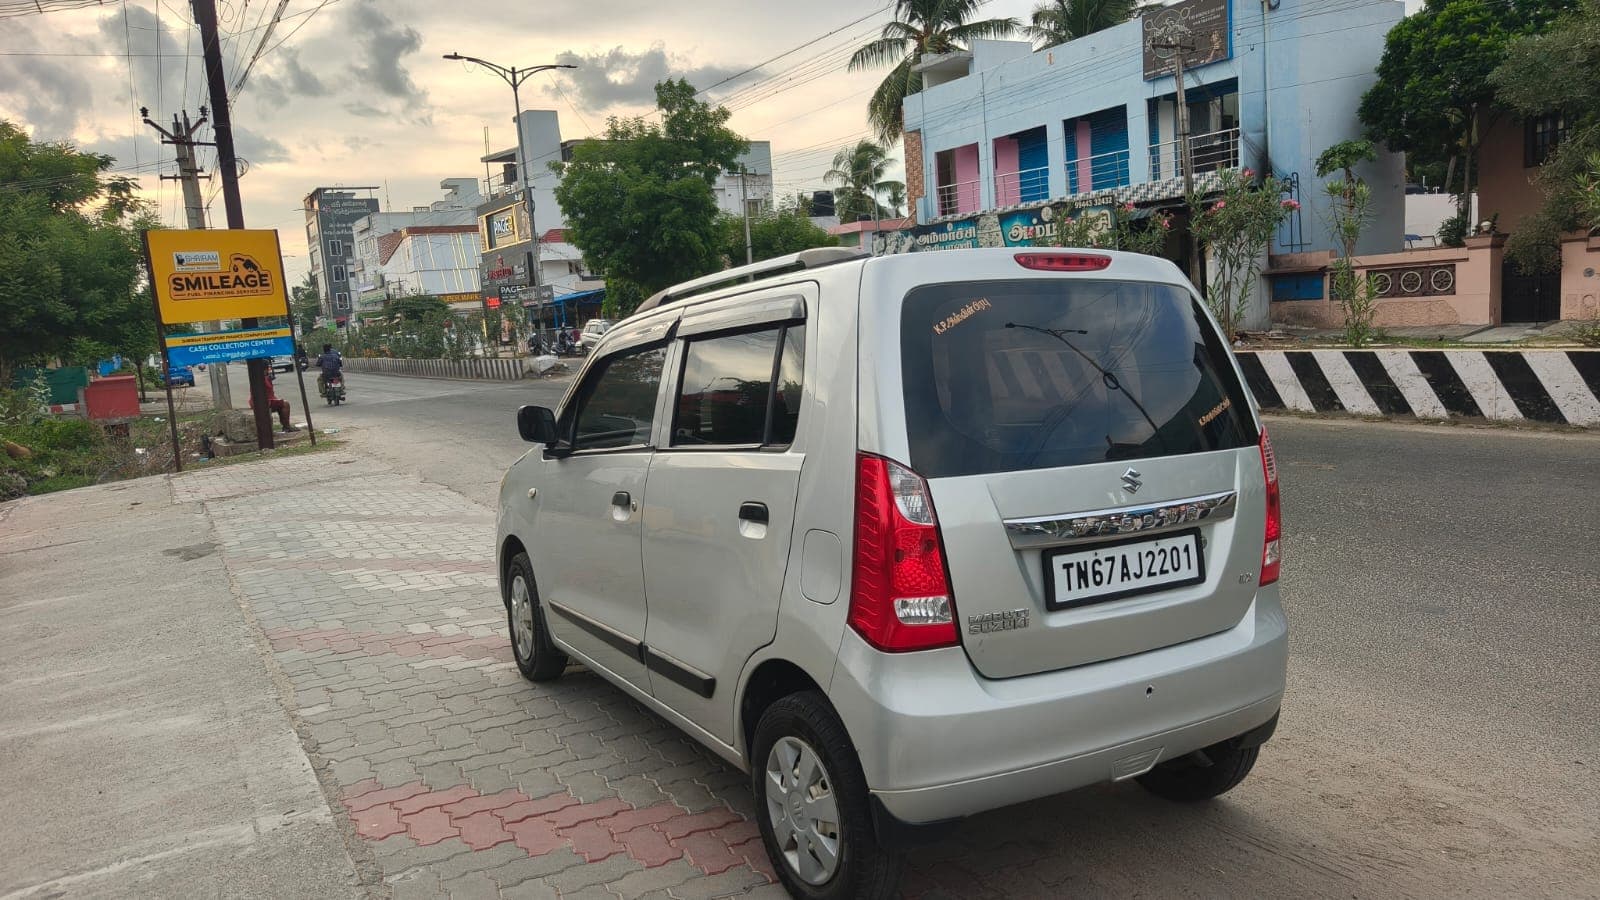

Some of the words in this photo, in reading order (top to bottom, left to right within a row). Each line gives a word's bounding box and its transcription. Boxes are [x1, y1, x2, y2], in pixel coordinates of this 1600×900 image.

[185, 254, 218, 263] SHRIRAM
[172, 273, 270, 292] SMILEAGE
[188, 345, 207, 353] CASH
[208, 342, 250, 351] COLLECTION
[250, 339, 275, 347] CENTRE
[1062, 543, 1192, 592] TN67AJ2201
[968, 607, 1030, 623] MARUTI
[968, 617, 1030, 635] SUZUKI
